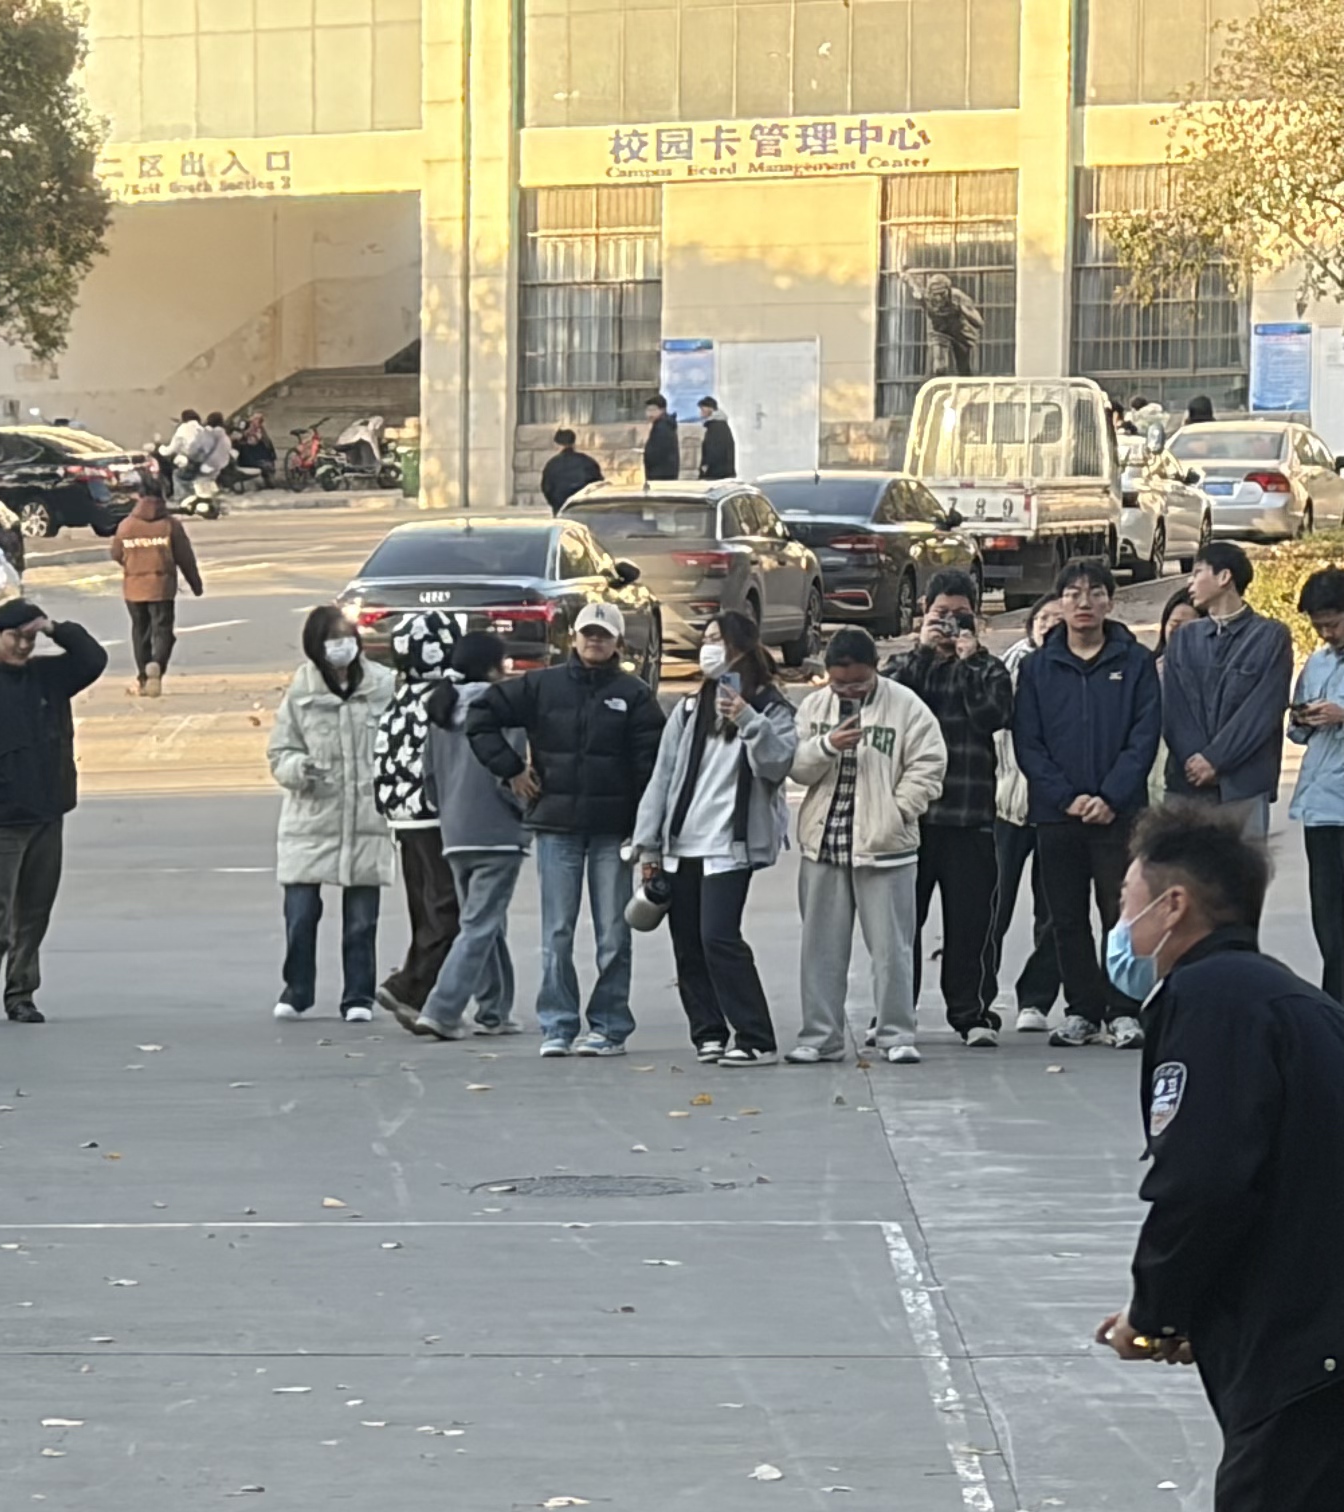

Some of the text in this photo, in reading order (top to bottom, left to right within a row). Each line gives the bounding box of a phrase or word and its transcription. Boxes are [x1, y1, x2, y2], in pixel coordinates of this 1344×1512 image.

[608, 118, 931, 164] 校园卡管理中心
